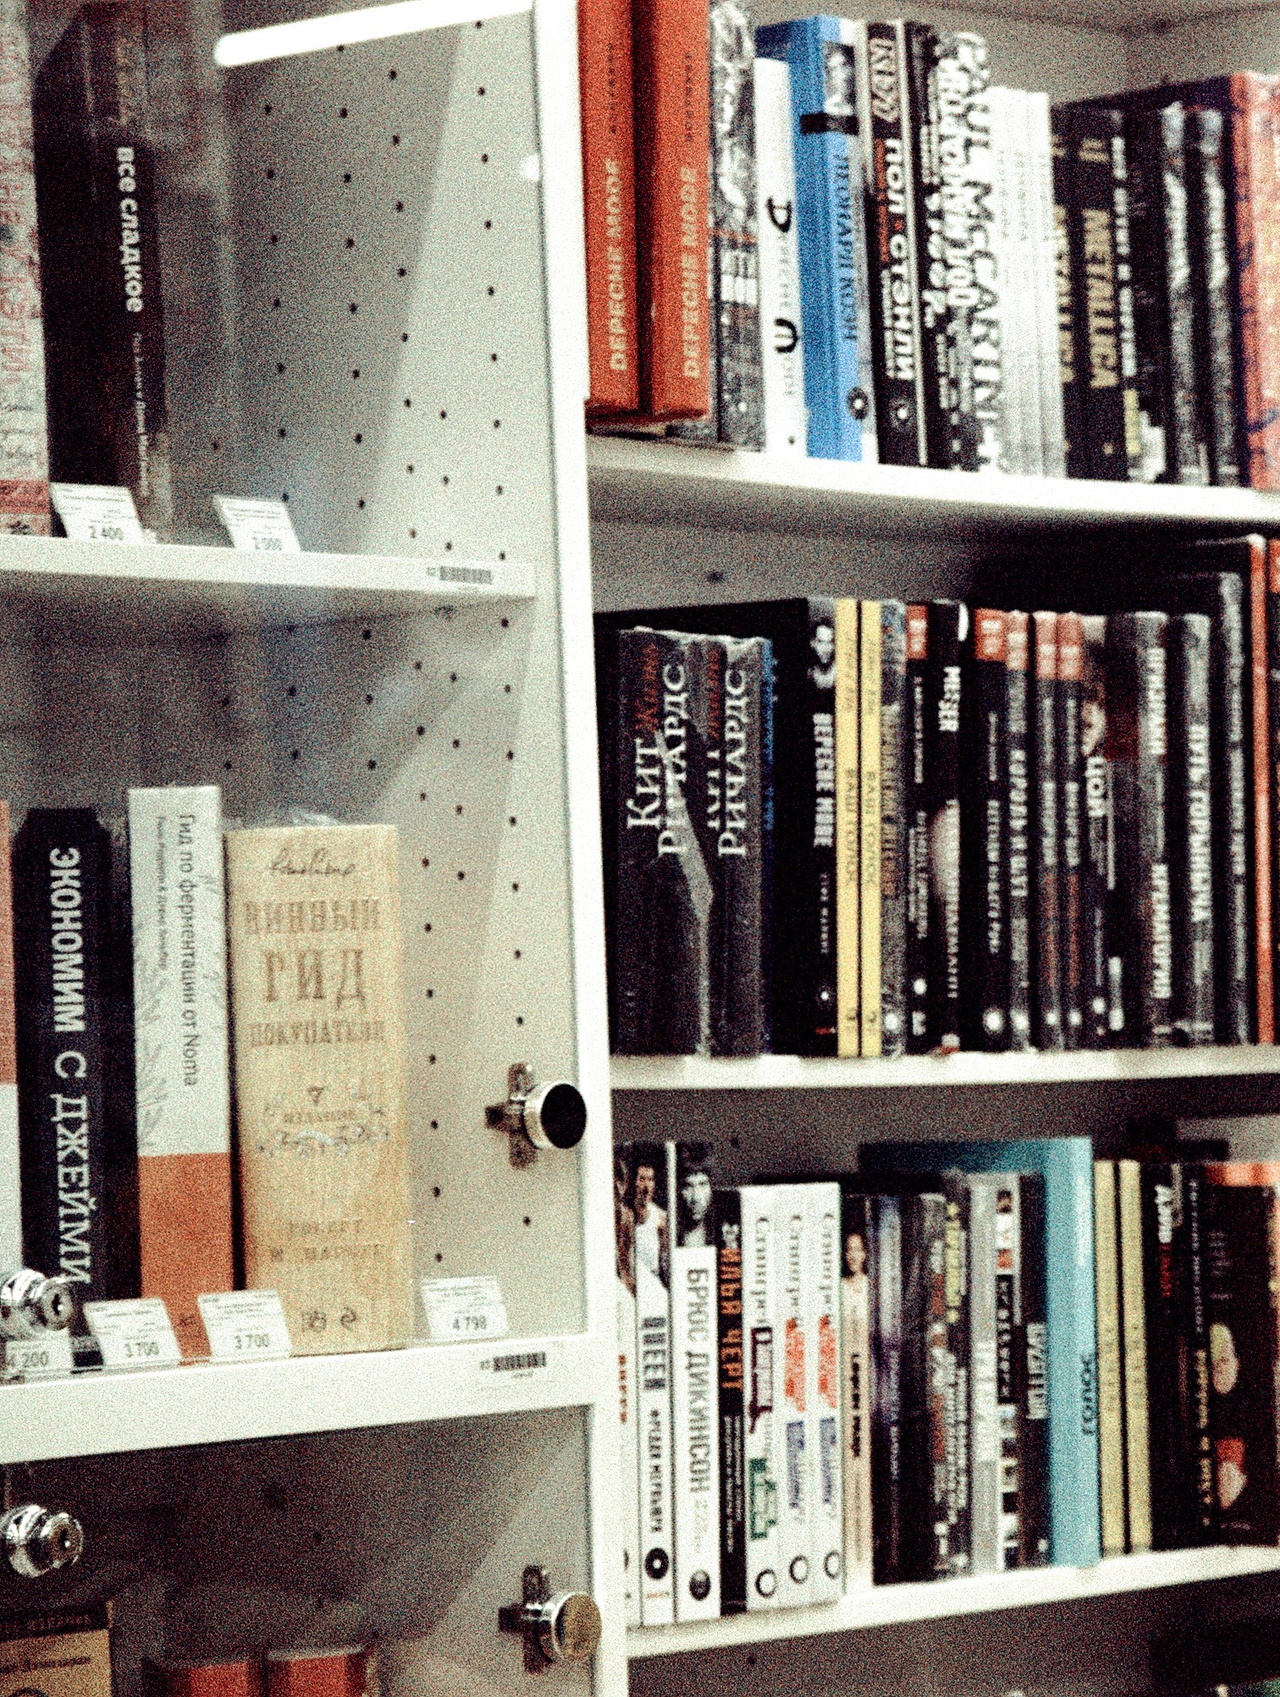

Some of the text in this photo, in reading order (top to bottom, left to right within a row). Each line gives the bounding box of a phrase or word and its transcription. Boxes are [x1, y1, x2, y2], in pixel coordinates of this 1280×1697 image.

[958, 38, 994, 163] PAUL
[116, 146, 144, 313] все сладкое
[604, 157, 628, 371] DEPECHE MODE
[679, 166, 702, 378] DEPECHE MODE
[834, 154, 858, 343] ЛЕОНАРД КОЭН
[885, 138, 915, 381] ПОЛ СТЭНЛИ
[1083, 209, 1119, 390] METALLICA
[717, 668, 750, 858] РИЧАРДС
[937, 666, 961, 732] MESSER
[812, 712, 833, 847] DEPECHE MODE
[843, 767, 857, 887] ВАШ ГОЛОС
[864, 769, 878, 888] ВАШ ГОЛОС
[1009, 749, 1028, 832] КОРОЛЬ
[1010, 836, 1028, 850] И
[1083, 756, 1108, 819] ЦОЙ
[1148, 647, 1172, 999] ПРИЗРАКИ КРЕМАТОРИЯ
[1189, 724, 1210, 922] ПУТЬ ГОРЫНЫЧА
[176, 813, 203, 1087] Гид по ферментации от Noma
[262, 949, 367, 1011] ГИД
[49, 846, 97, 1284] ЭКОНОМИМ С ДЖЕЙМИ
[250, 1020, 387, 1048] ПОКУПАТЕЛЯ
[21, 1350, 49, 1369] 200
[642, 1315, 668, 1392] QUEEN
[686, 1267, 711, 1342] БРЮС
[719, 1248, 743, 1392] ИЛЬЯ ЧЕРТ
[685, 1350, 712, 1493] ДИКИНСОН
